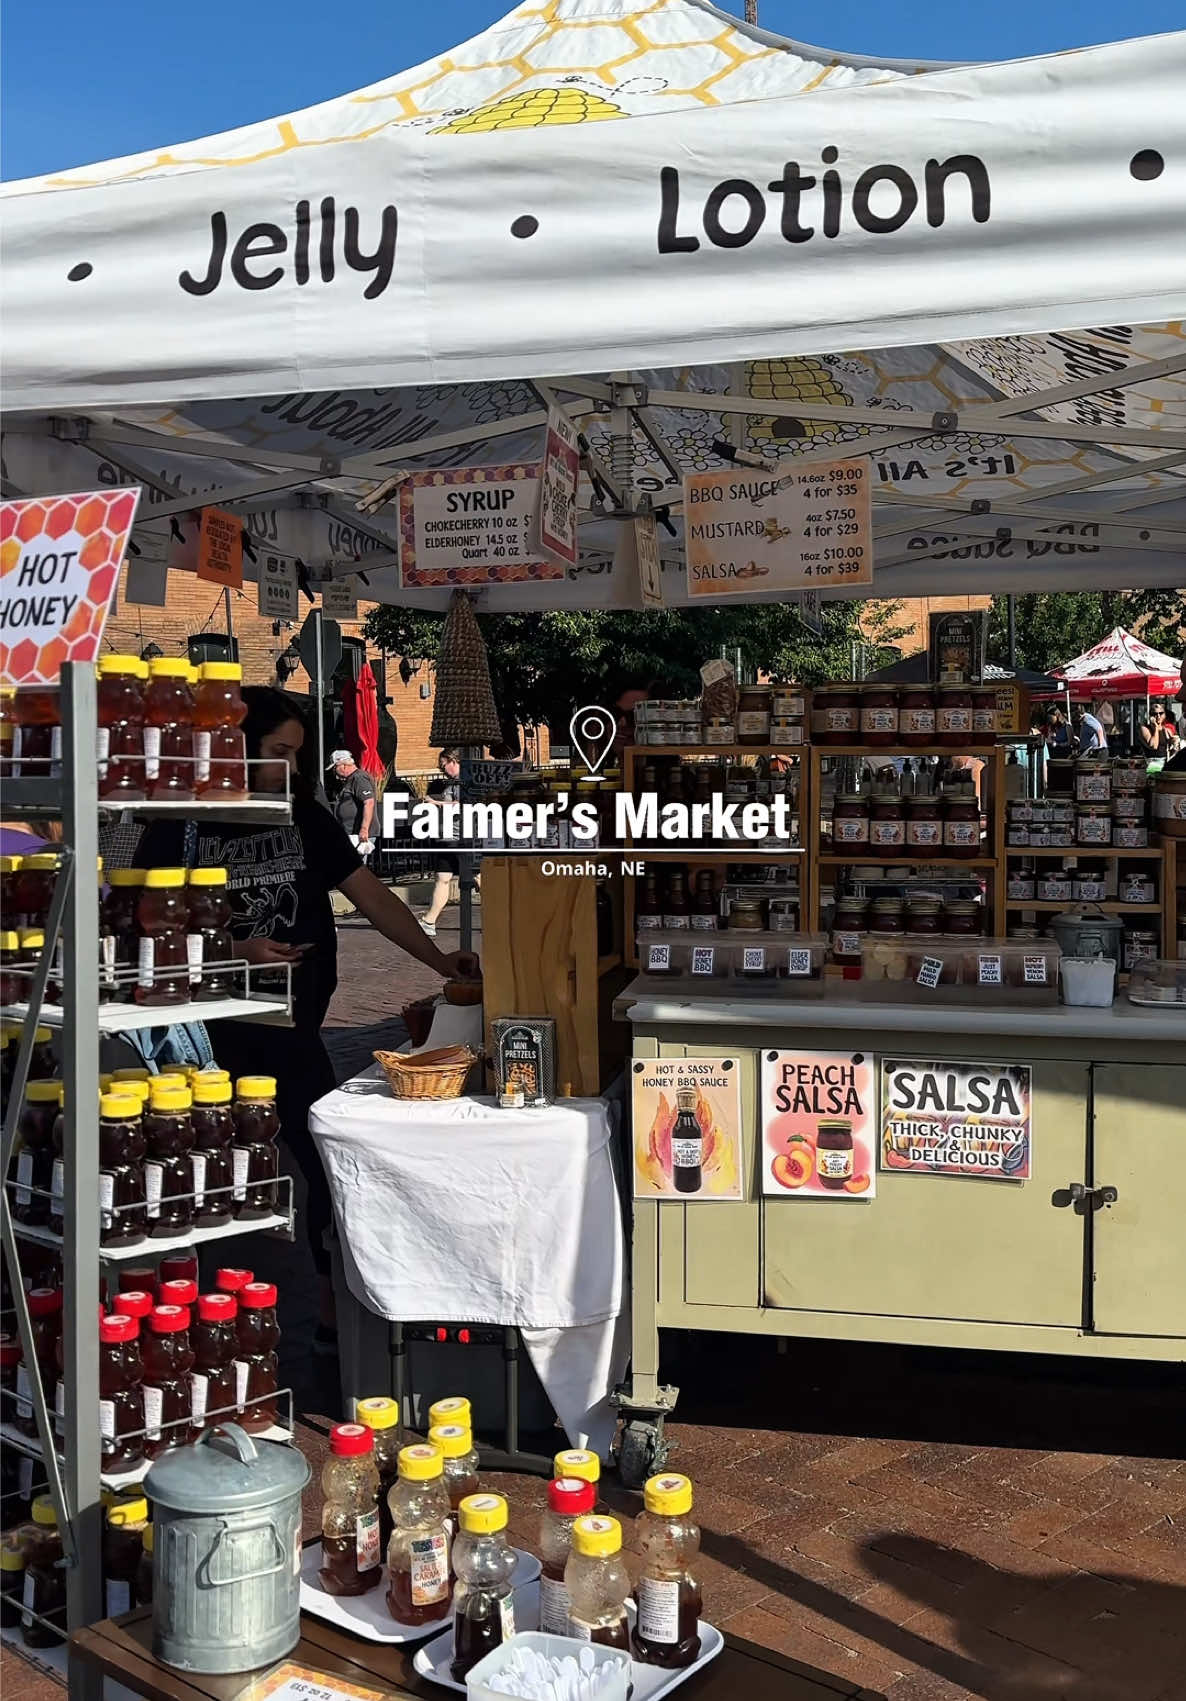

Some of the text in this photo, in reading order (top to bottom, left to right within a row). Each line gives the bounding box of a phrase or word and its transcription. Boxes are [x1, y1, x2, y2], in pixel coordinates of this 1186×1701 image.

[178, 145, 991, 299] Jelly Lotion
[829, 468, 863, 481] $9.00
[690, 480, 778, 503] BBQ SAUCE
[803, 484, 858, 498] 4 for $35
[446, 489, 515, 513] SYRUP
[806, 508, 856, 522] 4oz $7.50
[424, 518, 490, 532] CHOKECHERRY
[492, 517, 503, 528] 10
[506, 518, 518, 528] oz
[691, 520, 764, 539] MUSTARD
[803, 523, 859, 538] 4 for $29
[425, 535, 481, 549] ELDERHONEY
[486, 534, 504, 546] 14.5
[506, 533, 518, 544] oz
[462, 546, 520, 560] Quart 40 oz
[800, 546, 864, 561] 16oz $10.00
[18, 552, 77, 587] HOT
[692, 562, 738, 580] SALSA
[804, 562, 859, 576] 4 for $39
[0, 594, 78, 629] HONEY
[225, 871, 296, 890] ORLD PREMIERE
[505, 1050, 537, 1059] PRETZELS
[656, 1065, 714, 1074] HOT & SASSY
[782, 1064, 855, 1086] PEACH
[642, 1078, 728, 1087] HONEY BBQ SAUCE
[775, 1085, 864, 1115] SALSA
[892, 1072, 1021, 1116] SALSA
[890, 1122, 1023, 1142] THICK, CHUNKY
[950, 1139, 961, 1151] &
[911, 1149, 1000, 1167] DELICIOUS
